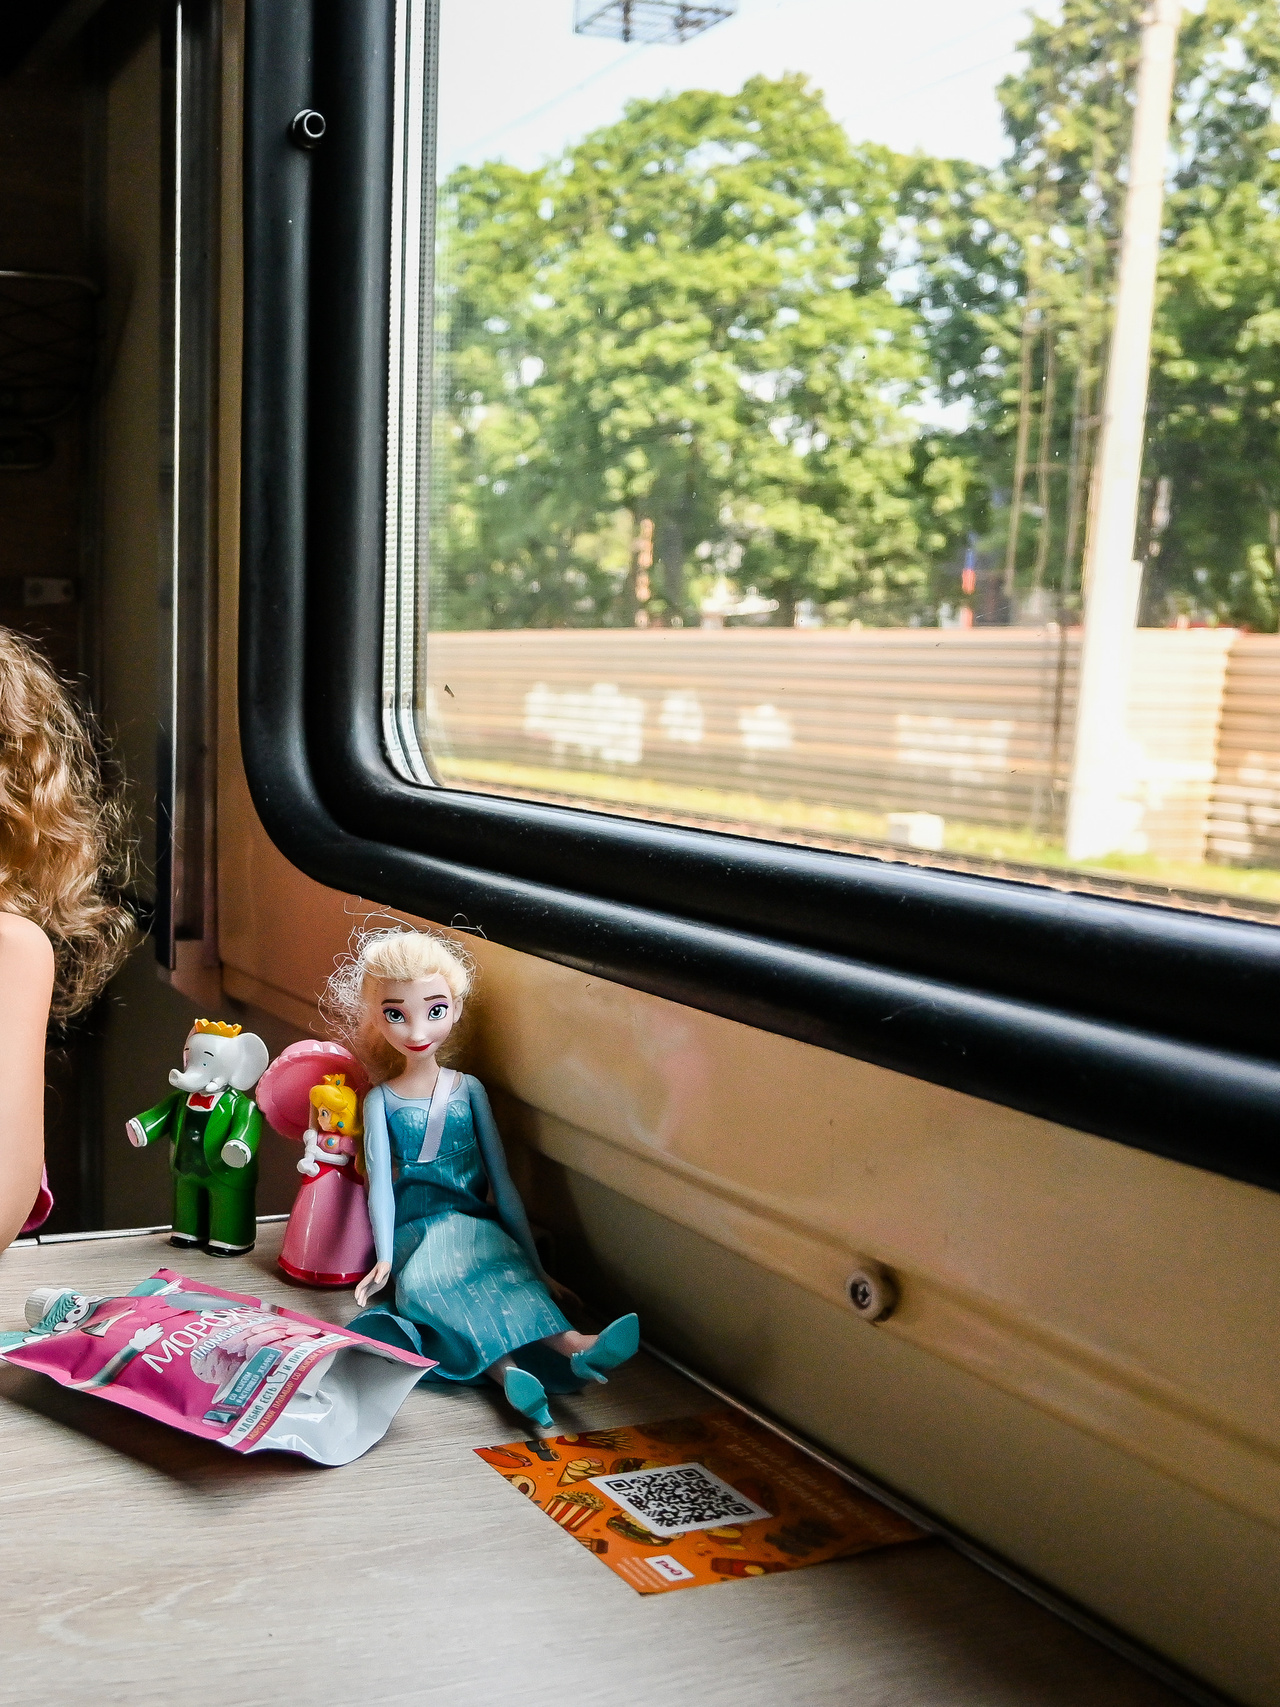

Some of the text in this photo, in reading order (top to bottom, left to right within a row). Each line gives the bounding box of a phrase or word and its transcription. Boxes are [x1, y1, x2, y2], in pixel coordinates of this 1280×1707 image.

[190, 1325, 243, 1360] ПЛОМБИР
[237, 1405, 264, 1433] УДОБНО
[260, 1385, 278, 1404] ЕСТЬ
[288, 1348, 308, 1364] ПИТЬ
